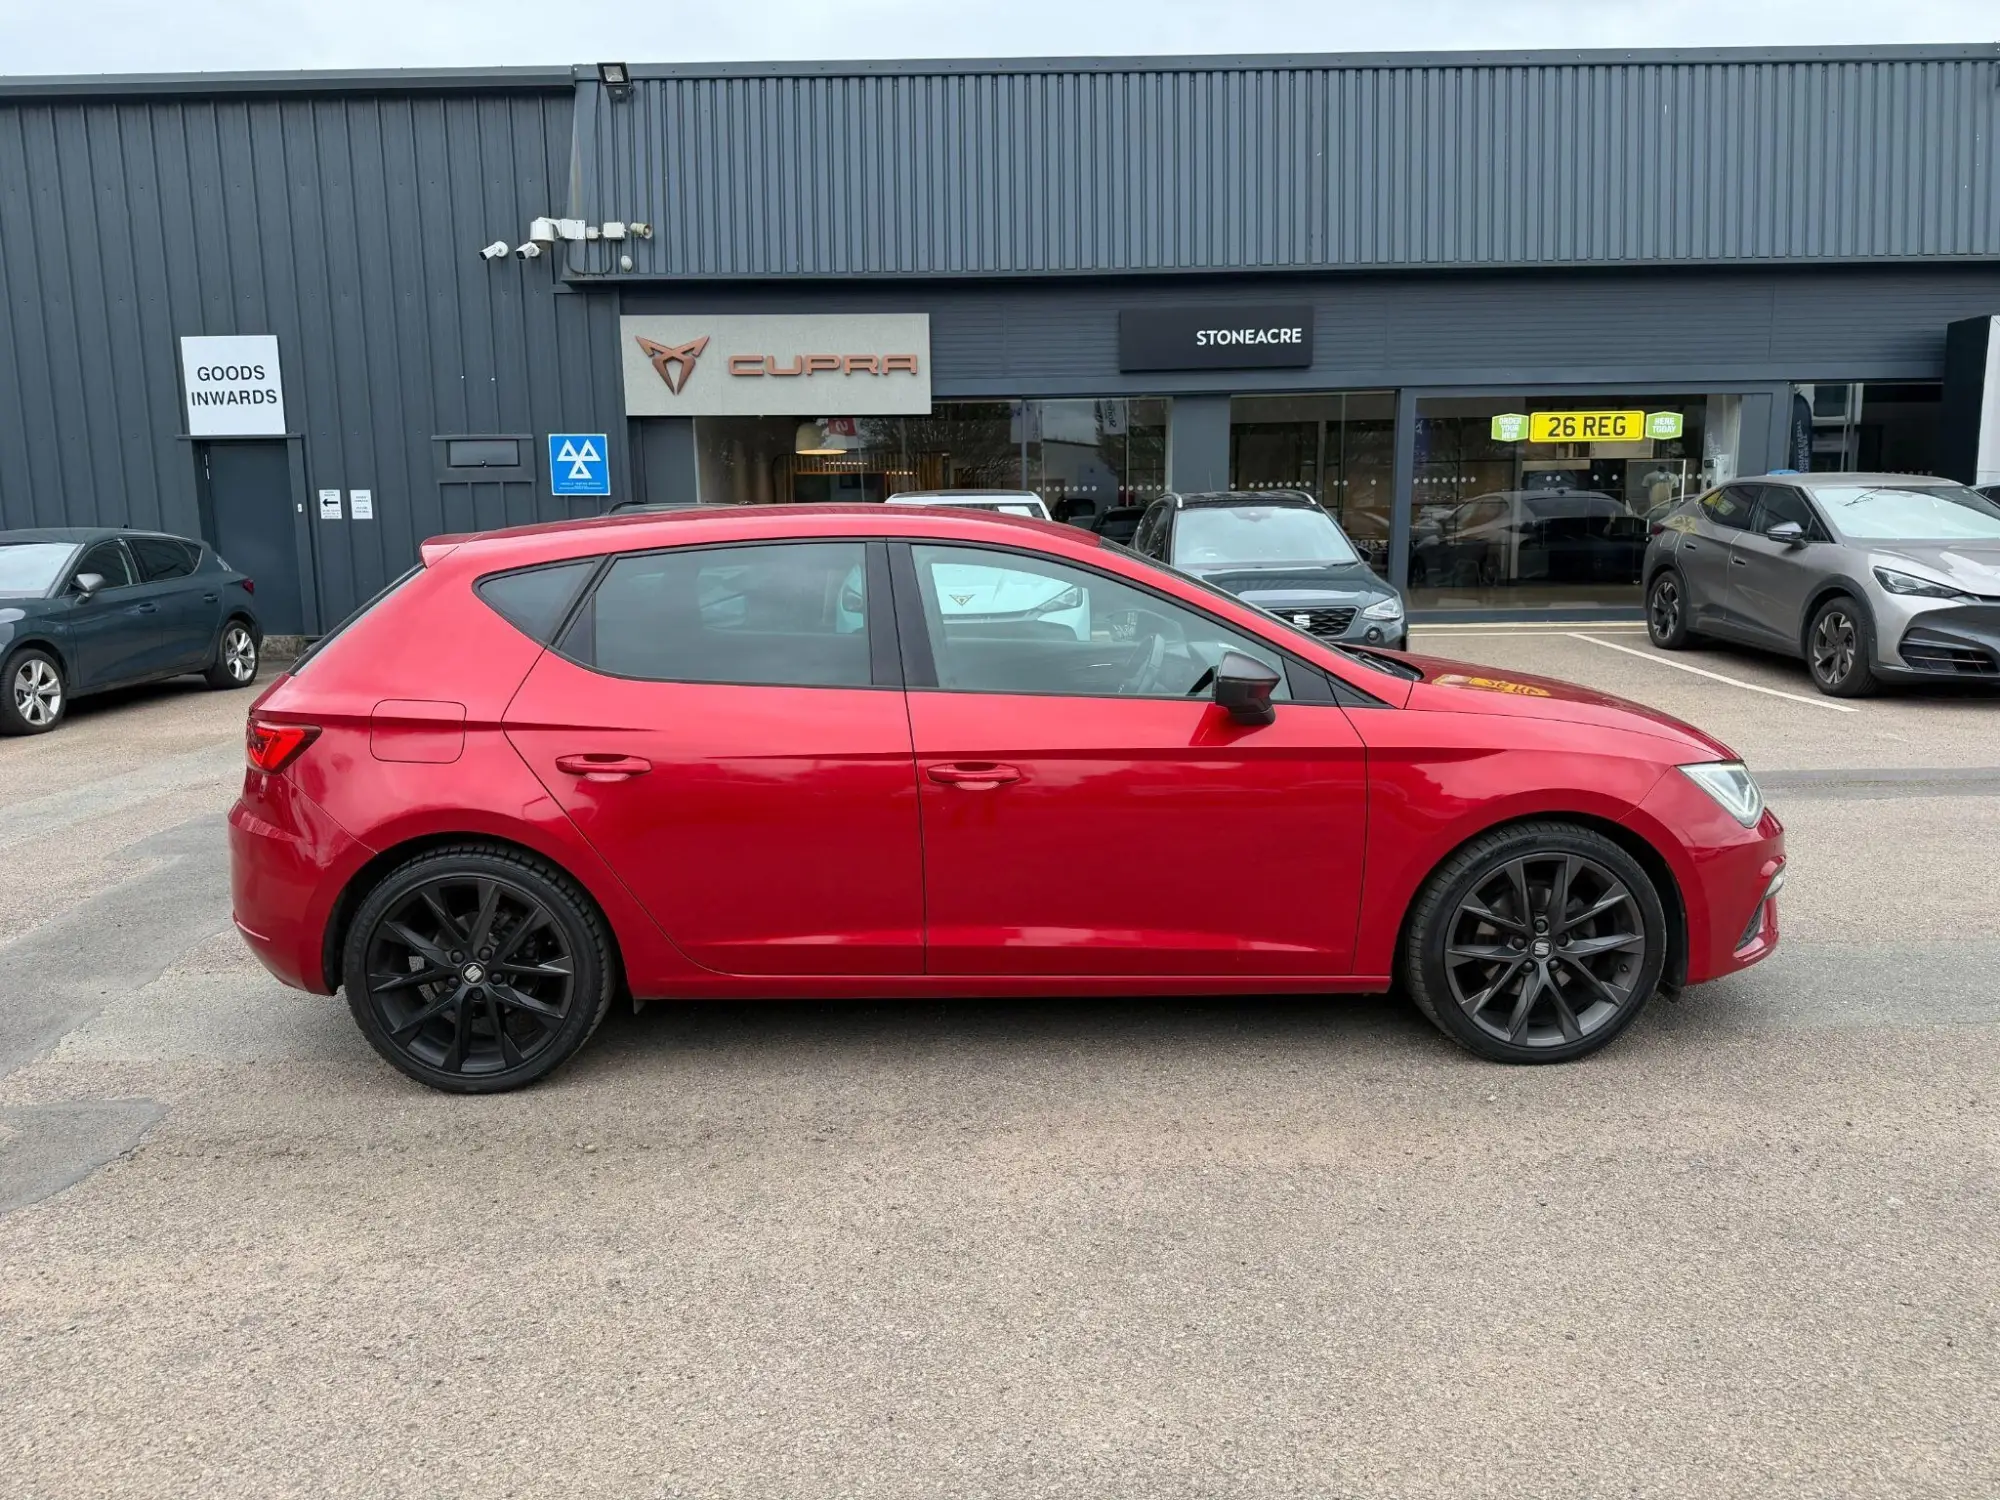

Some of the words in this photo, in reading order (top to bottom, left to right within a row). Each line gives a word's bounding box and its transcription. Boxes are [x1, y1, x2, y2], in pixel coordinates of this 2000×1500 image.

[1196, 328, 1302, 345] STONEACRE
[197, 365, 265, 381] GOODS
[728, 354, 918, 376] CUPRA
[191, 389, 277, 406] INWARDS
[1548, 416, 1576, 437] 26
[1583, 415, 1626, 437] REG
[1652, 425, 1676, 433] TODAY
